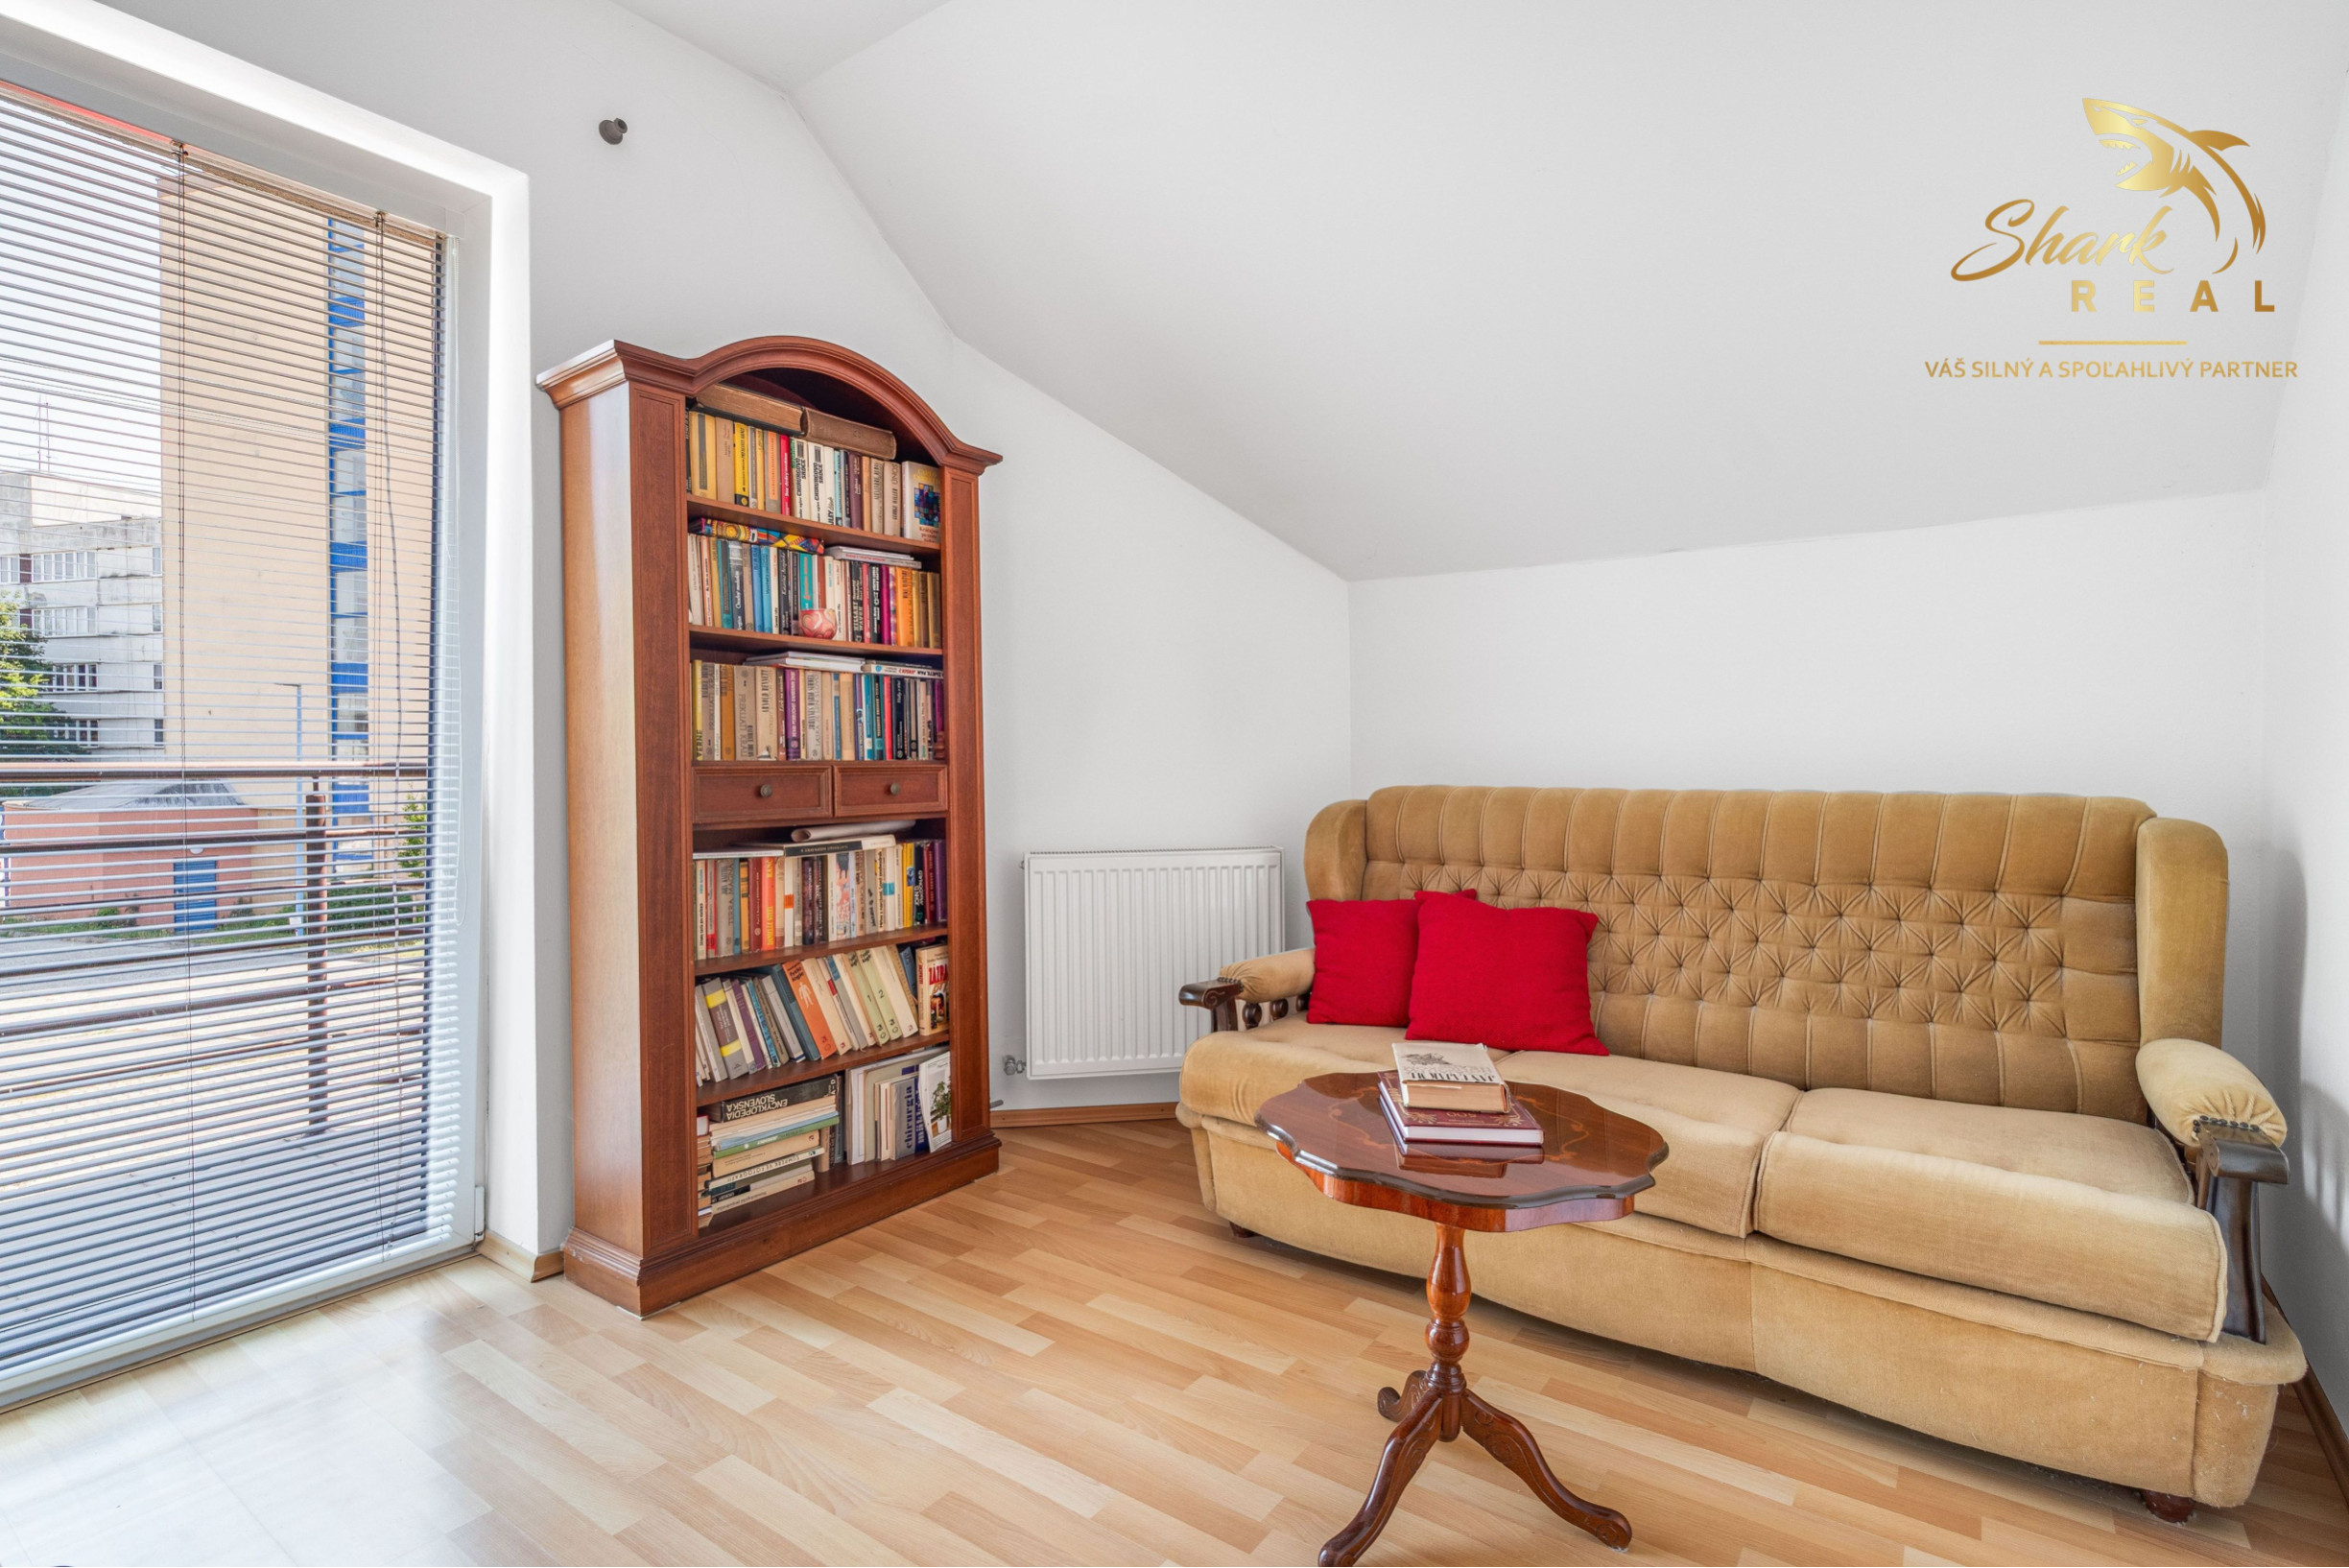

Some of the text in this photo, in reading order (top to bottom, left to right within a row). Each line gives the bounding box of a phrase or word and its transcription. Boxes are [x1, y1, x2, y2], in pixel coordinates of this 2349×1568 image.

[878, 989, 885, 999] 2
[726, 1094, 775, 1112] SLOVENSKA
[905, 1085, 914, 1149] chirurgia
